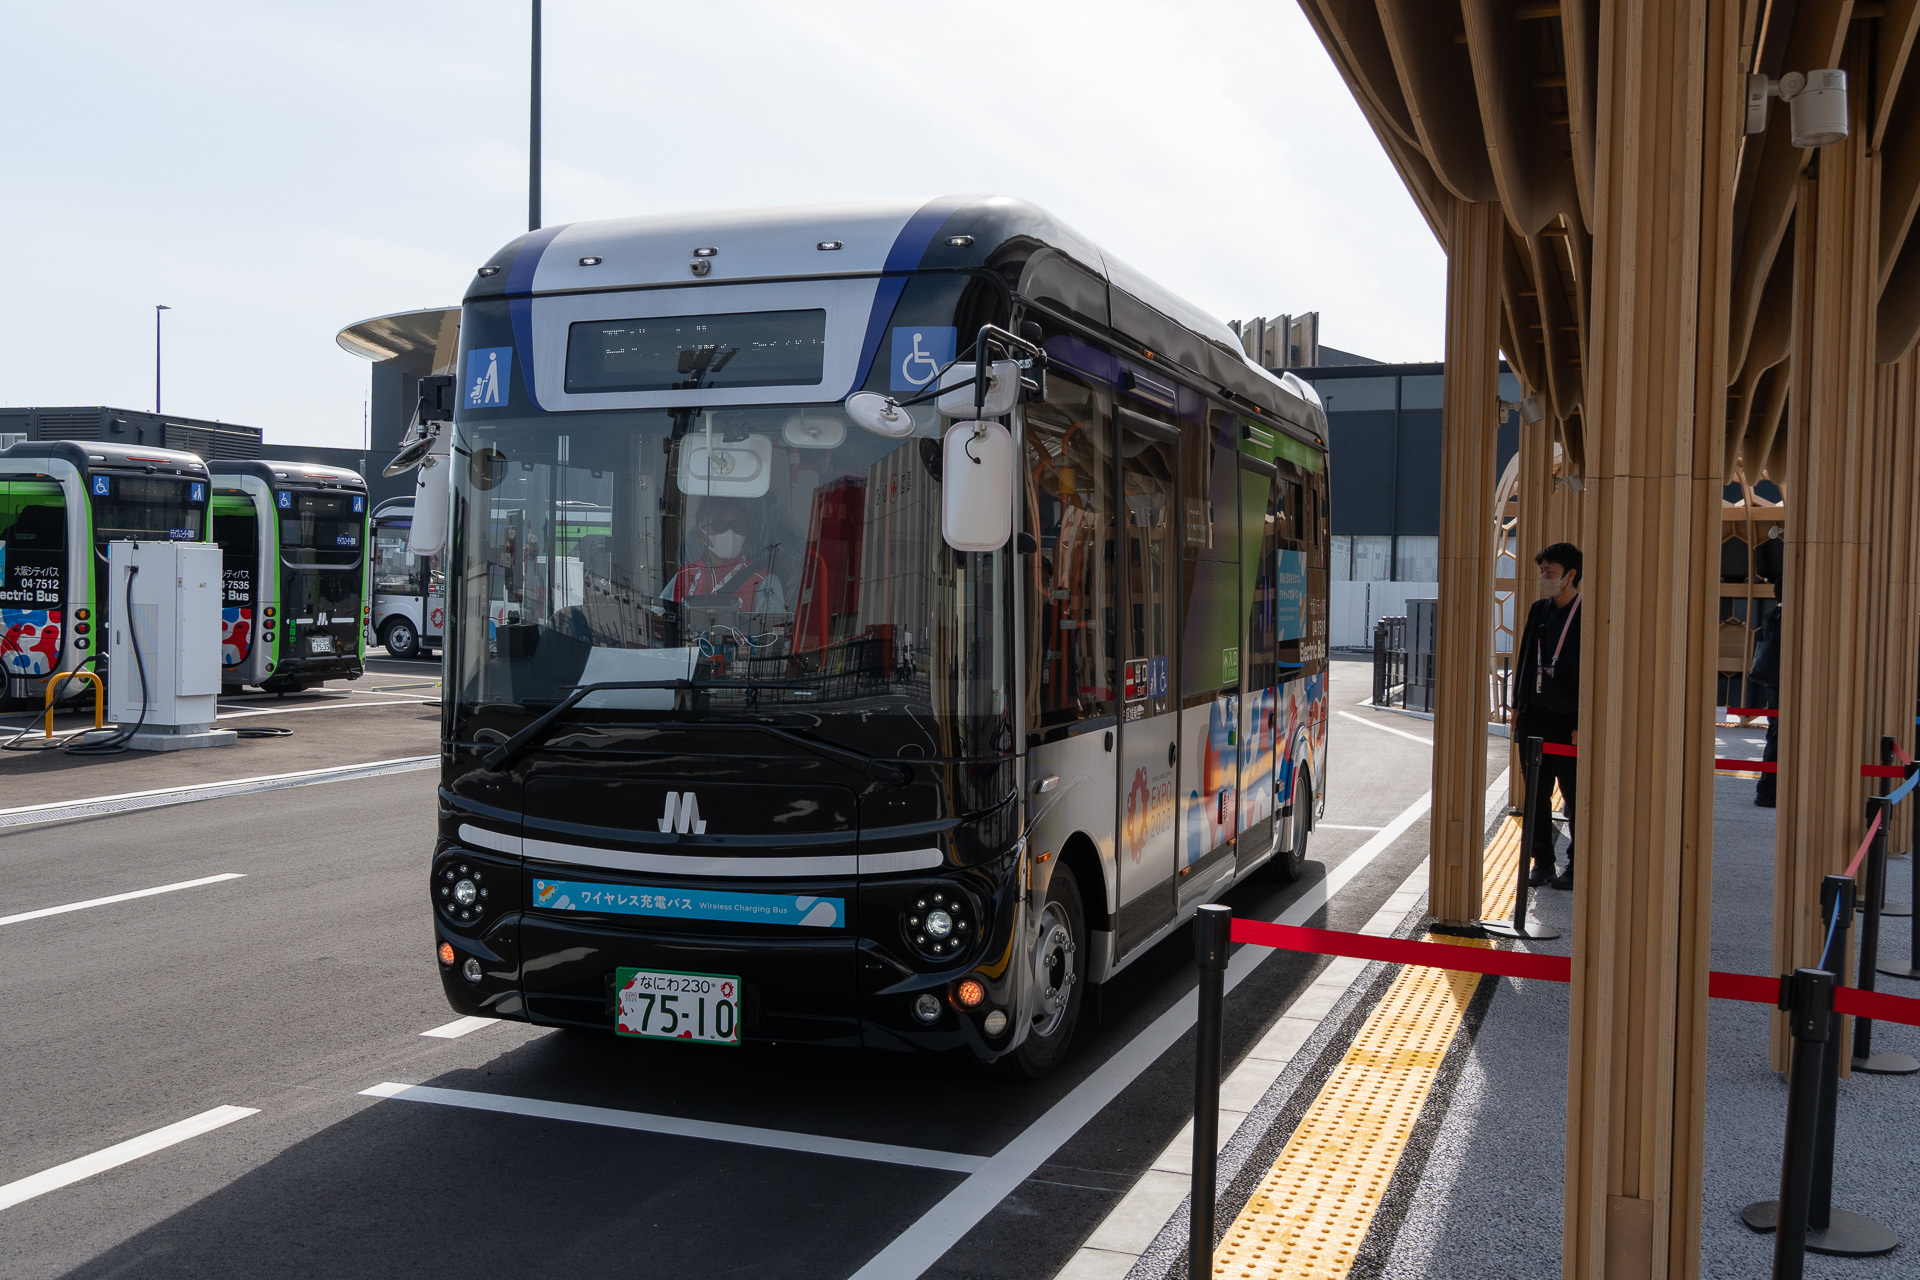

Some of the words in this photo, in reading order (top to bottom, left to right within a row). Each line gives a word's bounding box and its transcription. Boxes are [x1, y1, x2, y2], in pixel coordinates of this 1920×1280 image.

[14, 566, 59, 577] 大阪シティバス
[21, 579, 60, 589] 04-7512
[36, 590, 59, 603] Bus
[228, 590, 250, 602] Bus
[1228, 651, 1237, 668] 入口
[1299, 640, 1317, 663] Electric
[1317, 639, 1326, 659] Bus
[1135, 664, 1147, 684] 出口
[1151, 780, 1172, 810] EXPO
[1150, 807, 1171, 839] 2025
[581, 891, 692, 910] ワイヤレス充電バス
[699, 901, 733, 911] Wireless
[734, 903, 770, 914] Charging
[773, 906, 788, 914] Bus
[622, 1005, 634, 1016] い
[638, 993, 734, 1039] 75-10
